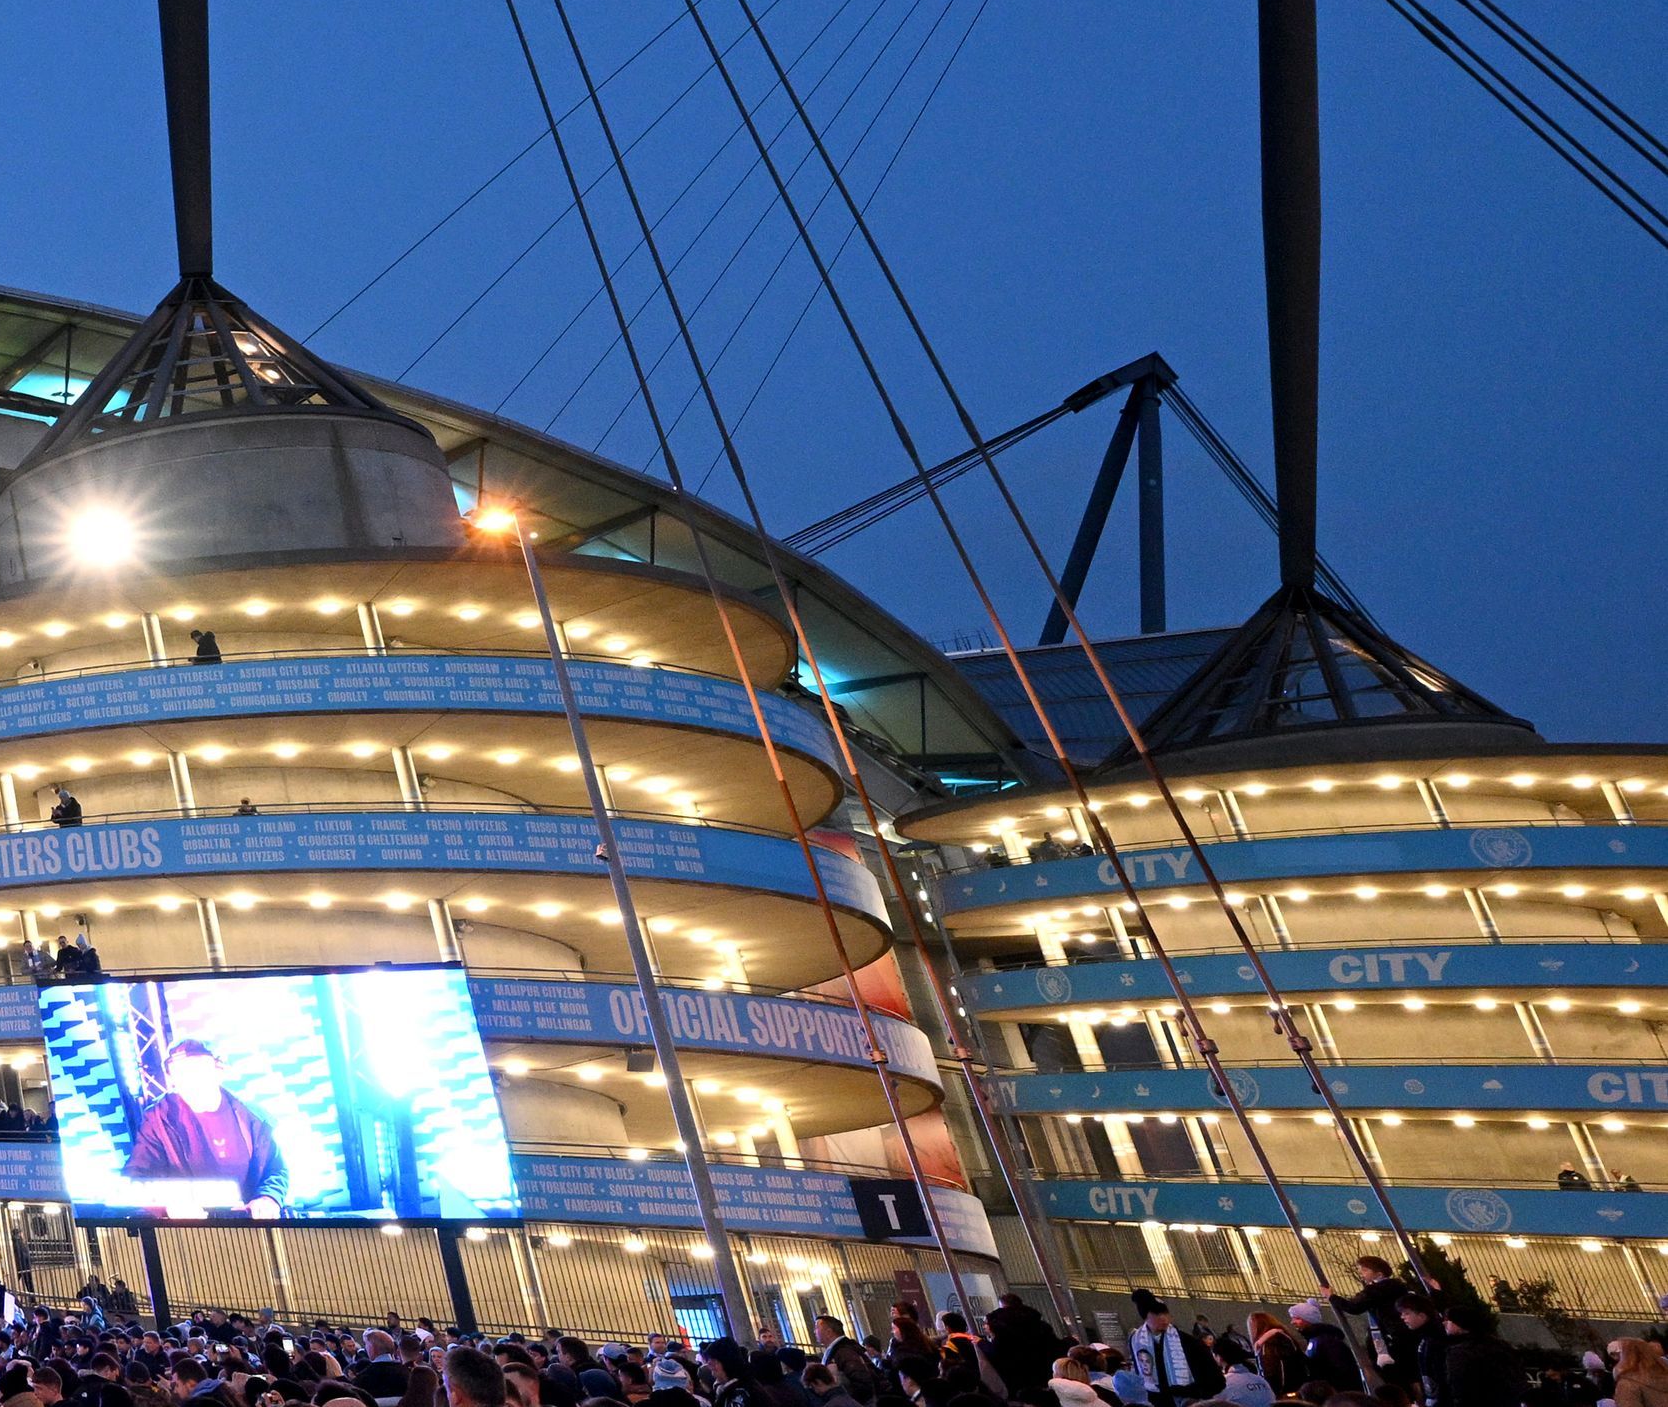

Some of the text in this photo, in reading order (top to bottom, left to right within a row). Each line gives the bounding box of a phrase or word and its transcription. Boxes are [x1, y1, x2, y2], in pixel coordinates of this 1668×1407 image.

[302, 664, 330, 676] BLUES
[347, 662, 384, 674] ATLANTA
[66, 827, 162, 873] CLUBS
[1098, 851, 1193, 886] CITY
[1329, 952, 1453, 984] CITY
[609, 989, 748, 1044] OFICIAL
[747, 1001, 890, 1064] SUPPORTES
[606, 1168, 635, 1180] BLUES
[564, 1199, 623, 1214] VANCOUVER
[878, 1194, 900, 1230] T
[1089, 1187, 1158, 1215] CITY
